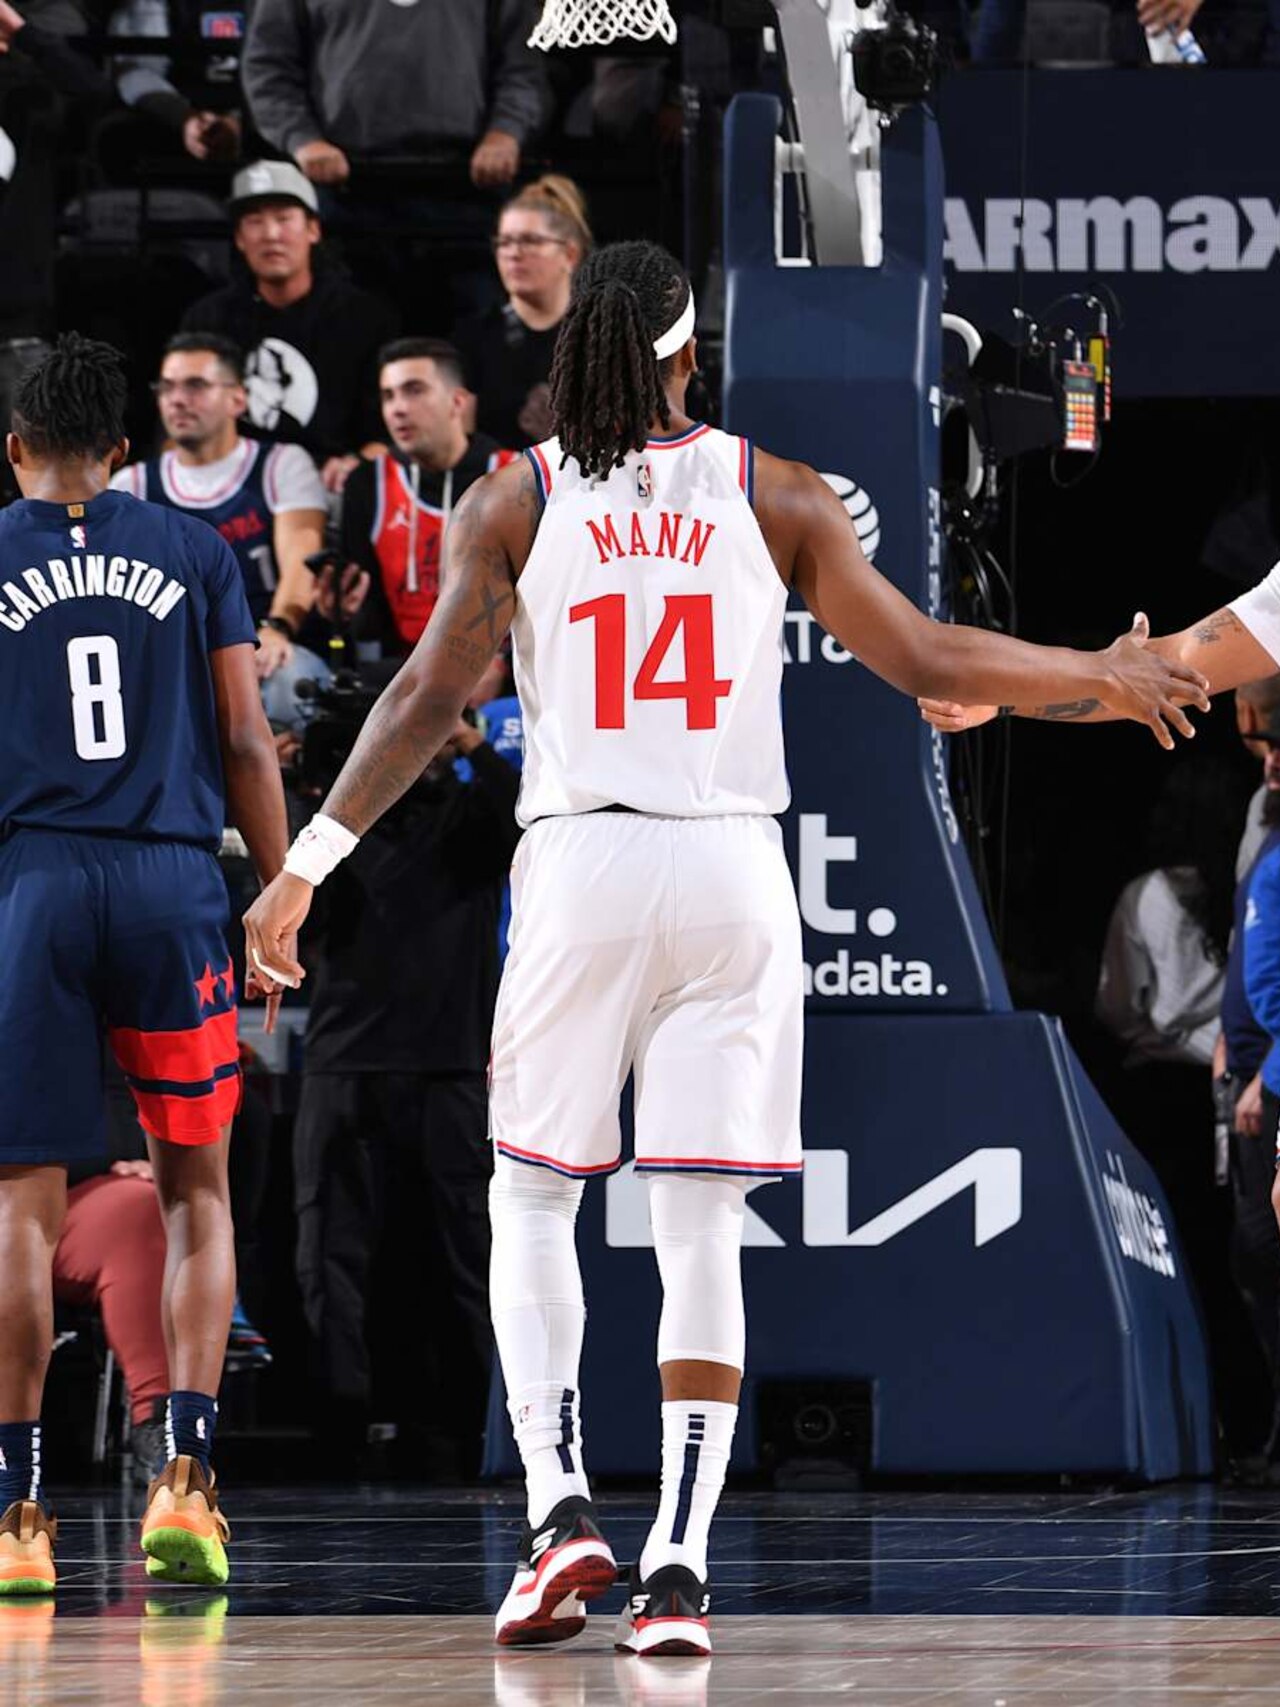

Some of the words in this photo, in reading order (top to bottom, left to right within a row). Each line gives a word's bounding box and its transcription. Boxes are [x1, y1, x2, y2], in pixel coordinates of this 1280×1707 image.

[585, 511, 716, 567] MANN
[0, 554, 187, 632] CARRINGTON
[67, 635, 127, 761] 8
[569, 593, 733, 730] 14
